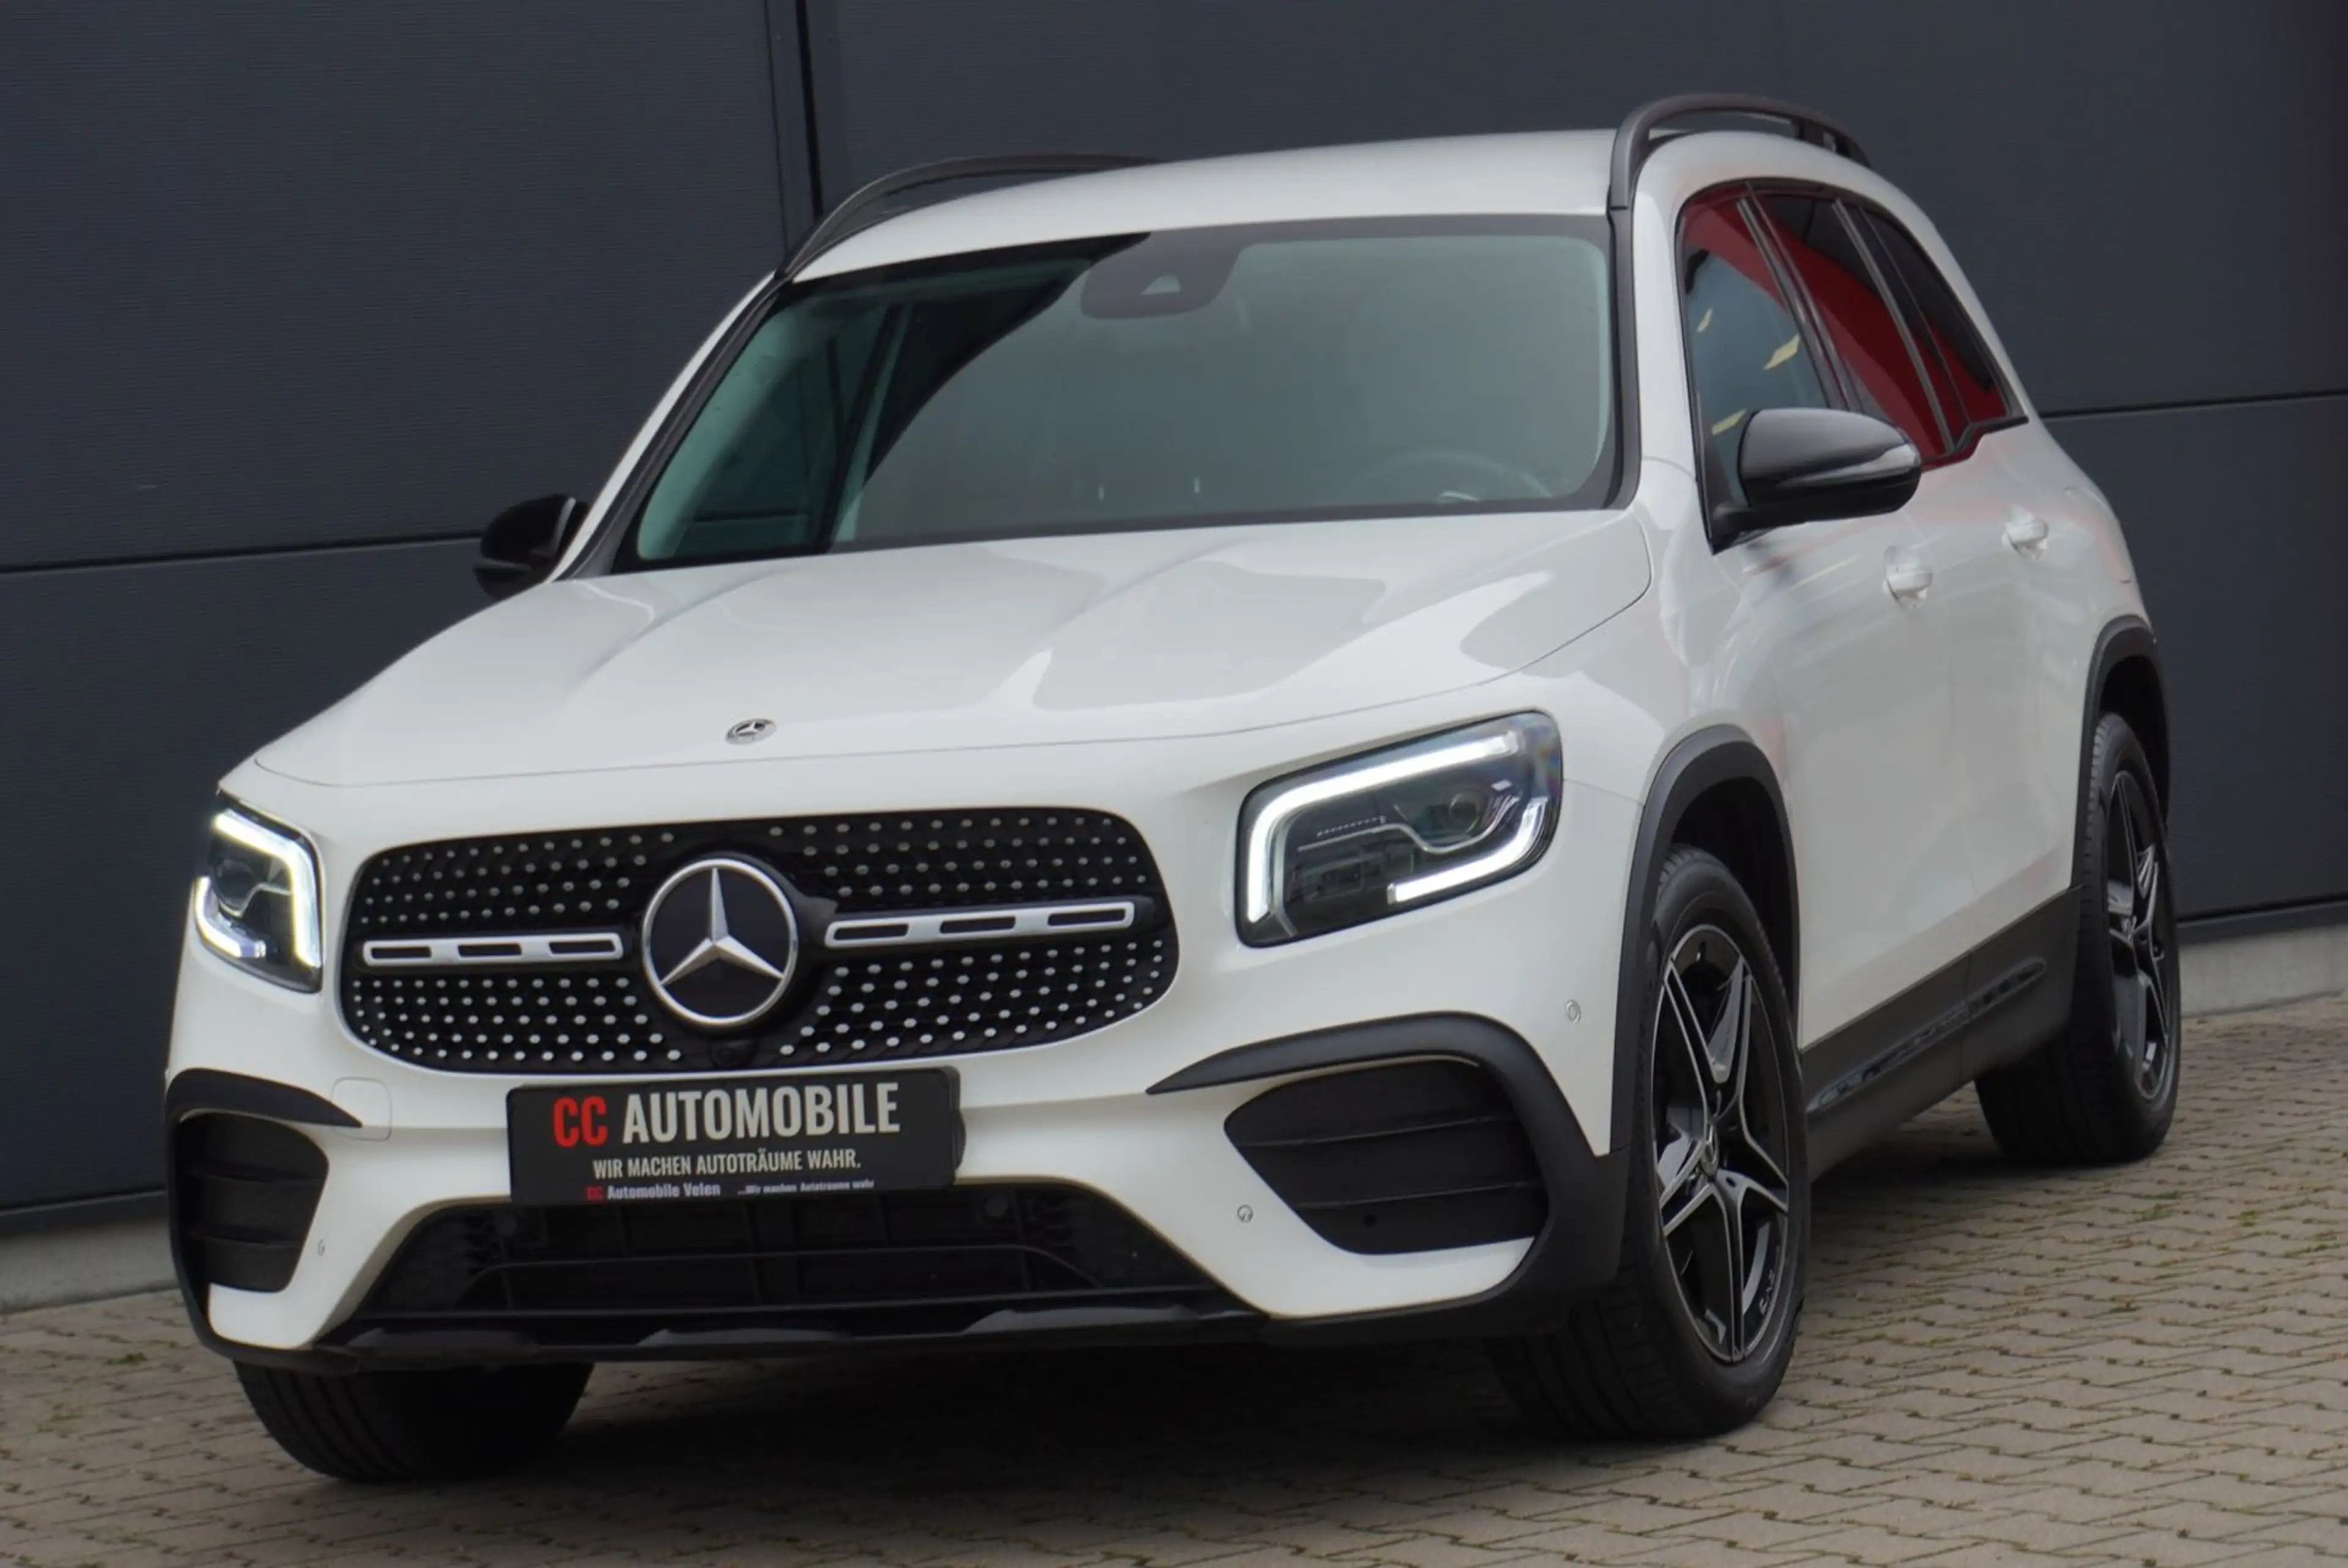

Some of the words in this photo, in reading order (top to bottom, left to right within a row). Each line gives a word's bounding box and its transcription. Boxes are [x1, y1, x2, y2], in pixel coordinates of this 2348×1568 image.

[553, 1096, 607, 1147] CC
[622, 1082, 900, 1144] AUTOMOBILE
[593, 1159, 622, 1179] WIR
[627, 1155, 692, 1177] MACHEN
[696, 1147, 803, 1175] AUTOTRÄUME
[807, 1149, 861, 1169] WAHR.
[607, 1183, 680, 1199] Automobile
